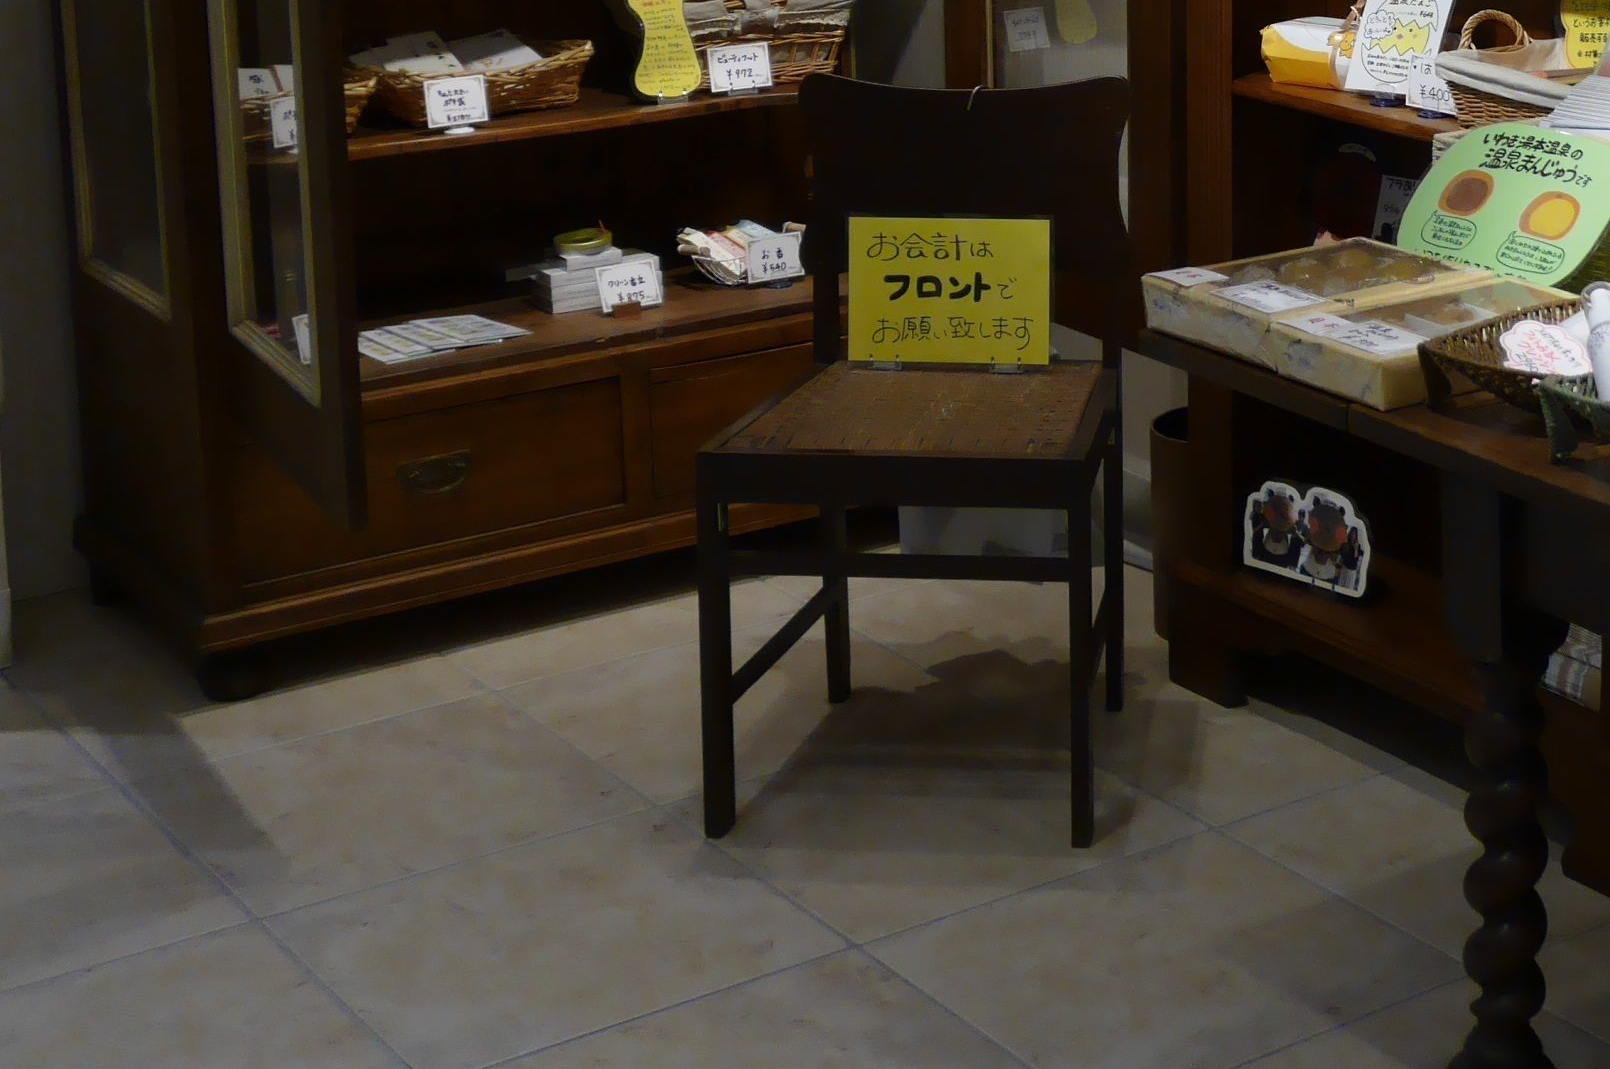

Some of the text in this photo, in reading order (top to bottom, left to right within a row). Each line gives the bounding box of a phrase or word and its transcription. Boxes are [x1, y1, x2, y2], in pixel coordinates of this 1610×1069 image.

[1483, 133, 1584, 161] いわき湯本温泉の
[1478, 147, 1593, 188] 温泉まんじゅうです
[866, 232, 994, 261] お会計は
[883, 272, 1017, 302] フロントで
[871, 316, 1034, 351] お願い致します
